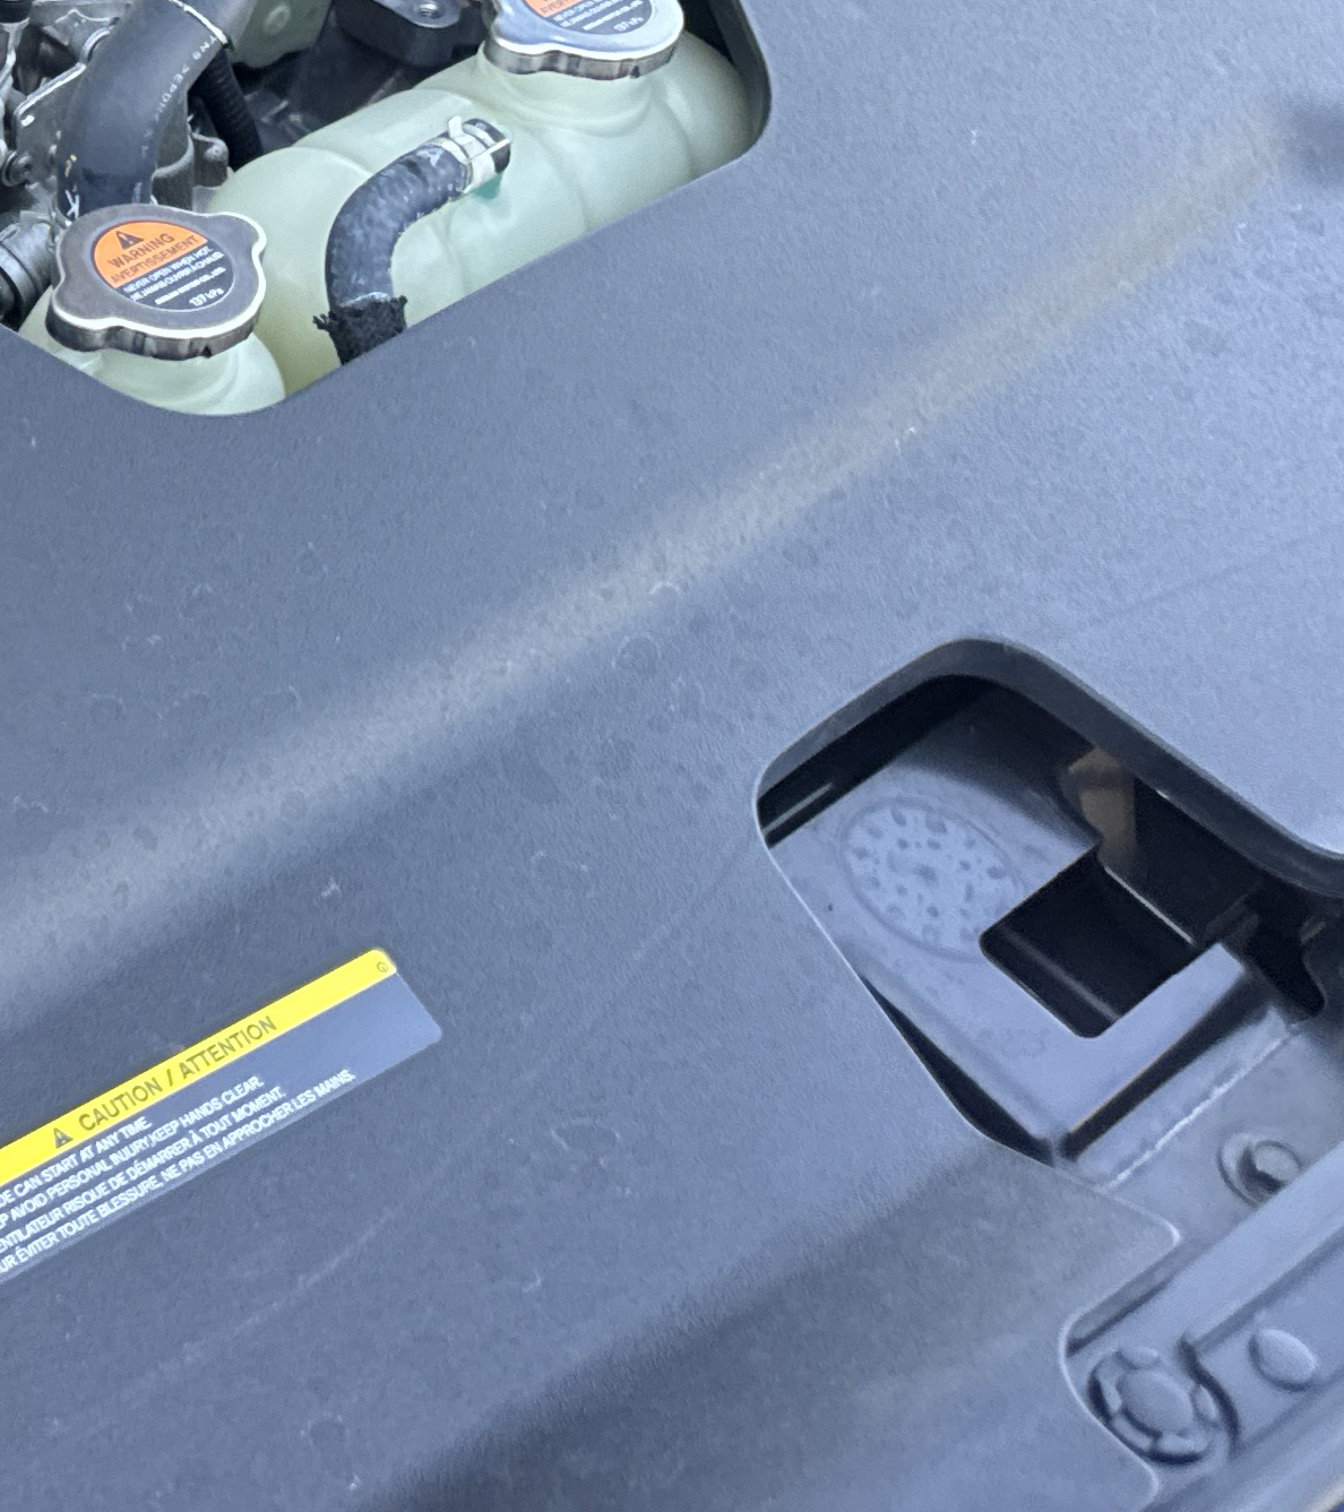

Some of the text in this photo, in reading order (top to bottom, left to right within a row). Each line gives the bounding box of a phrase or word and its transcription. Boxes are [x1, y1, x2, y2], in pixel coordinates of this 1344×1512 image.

[108, 233, 175, 268] WARNING
[111, 235, 199, 283] AVERTISSEMENT
[77, 1076, 163, 1133] CAUTION
[177, 1015, 277, 1079] ATTENTION
[8, 1192, 49, 1221] AVOID
[46, 1157, 113, 1201] PERSONAL
[179, 1097, 223, 1128] HANDS
[13, 1174, 43, 1198] CAN
[40, 1154, 80, 1183] START
[78, 1145, 96, 1162] AT
[94, 1131, 122, 1154] ANY
[14, 1230, 60, 1263] ÉVITER
[56, 1209, 99, 1241] TOUTE
[160, 1164, 181, 1183] NE
[178, 1150, 206, 1173] PAS
[203, 1141, 223, 1159] EN
[220, 1102, 294, 1149] APPROCHER
[291, 1089, 317, 1111] LES
[62, 1182, 111, 1216] RISQUE
[108, 1172, 128, 1190] DE
[125, 1137, 193, 1181] DÉMARRER
[199, 1114, 234, 1140] TOUT
